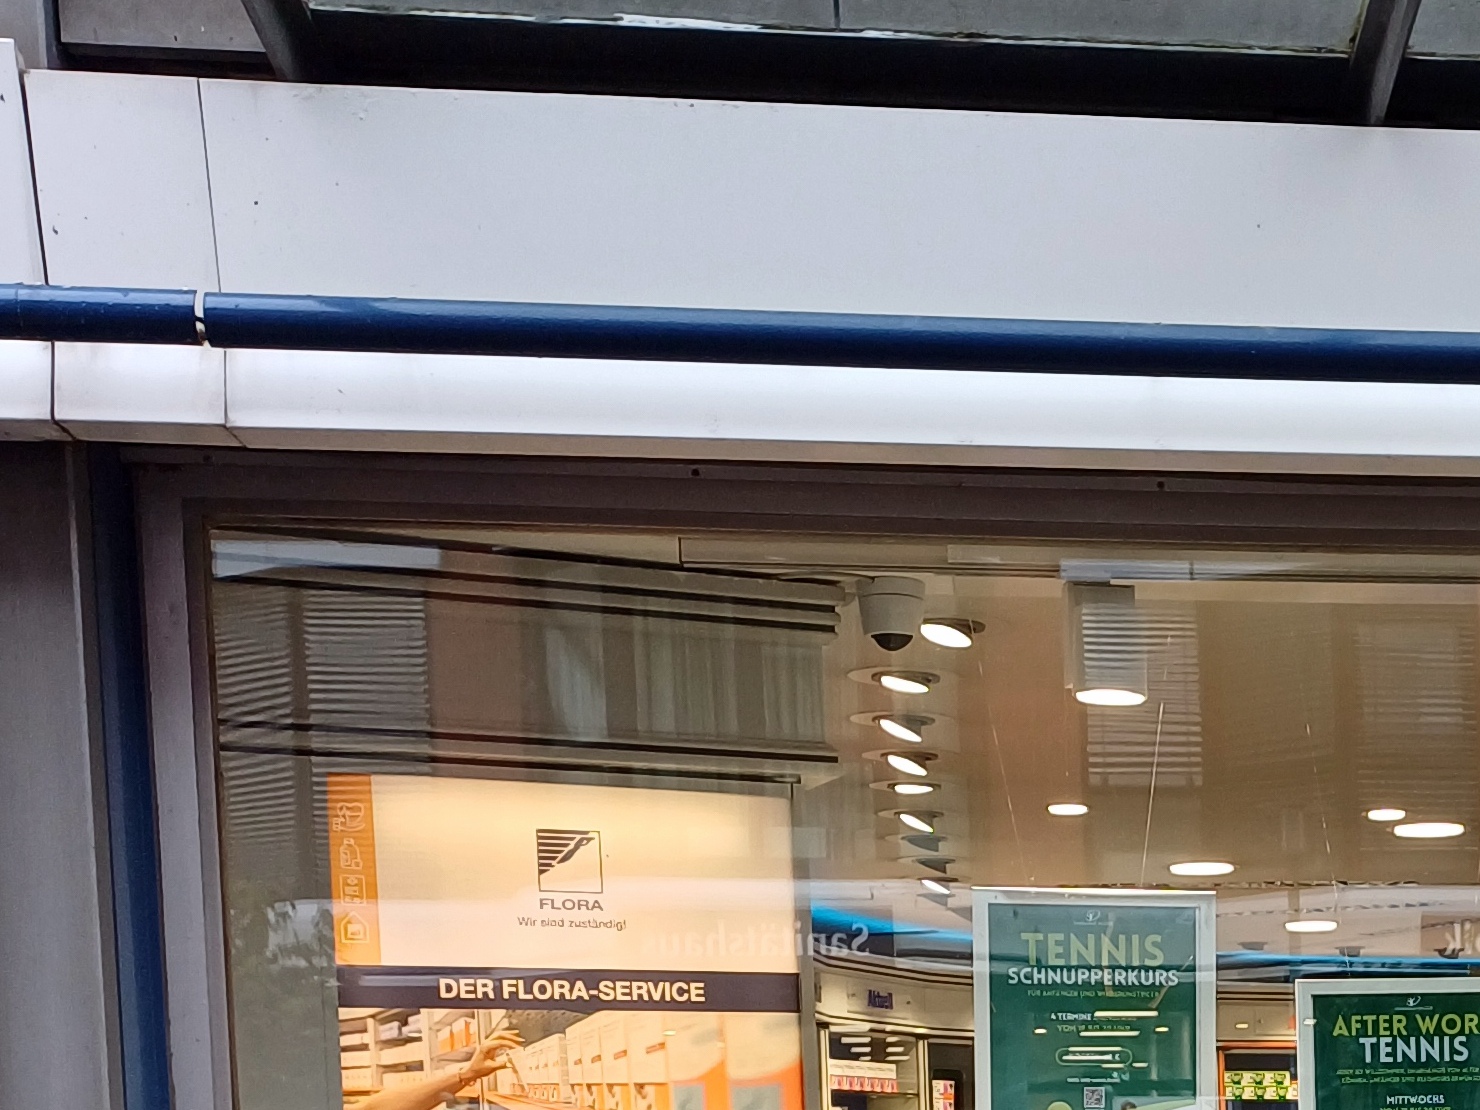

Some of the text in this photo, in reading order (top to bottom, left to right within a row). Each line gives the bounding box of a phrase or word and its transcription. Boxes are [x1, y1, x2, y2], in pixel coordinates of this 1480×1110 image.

[539, 898, 604, 911] FLORA
[517, 917, 537, 927] Wir
[1020, 932, 1164, 967] TENNIS
[1007, 967, 1179, 987] SCHNUPPERKURS
[438, 977, 705, 1002] DER FLORA-SERVICE
[1332, 1014, 1408, 1037] AFTER
[1359, 1035, 1470, 1063] TENNIS
